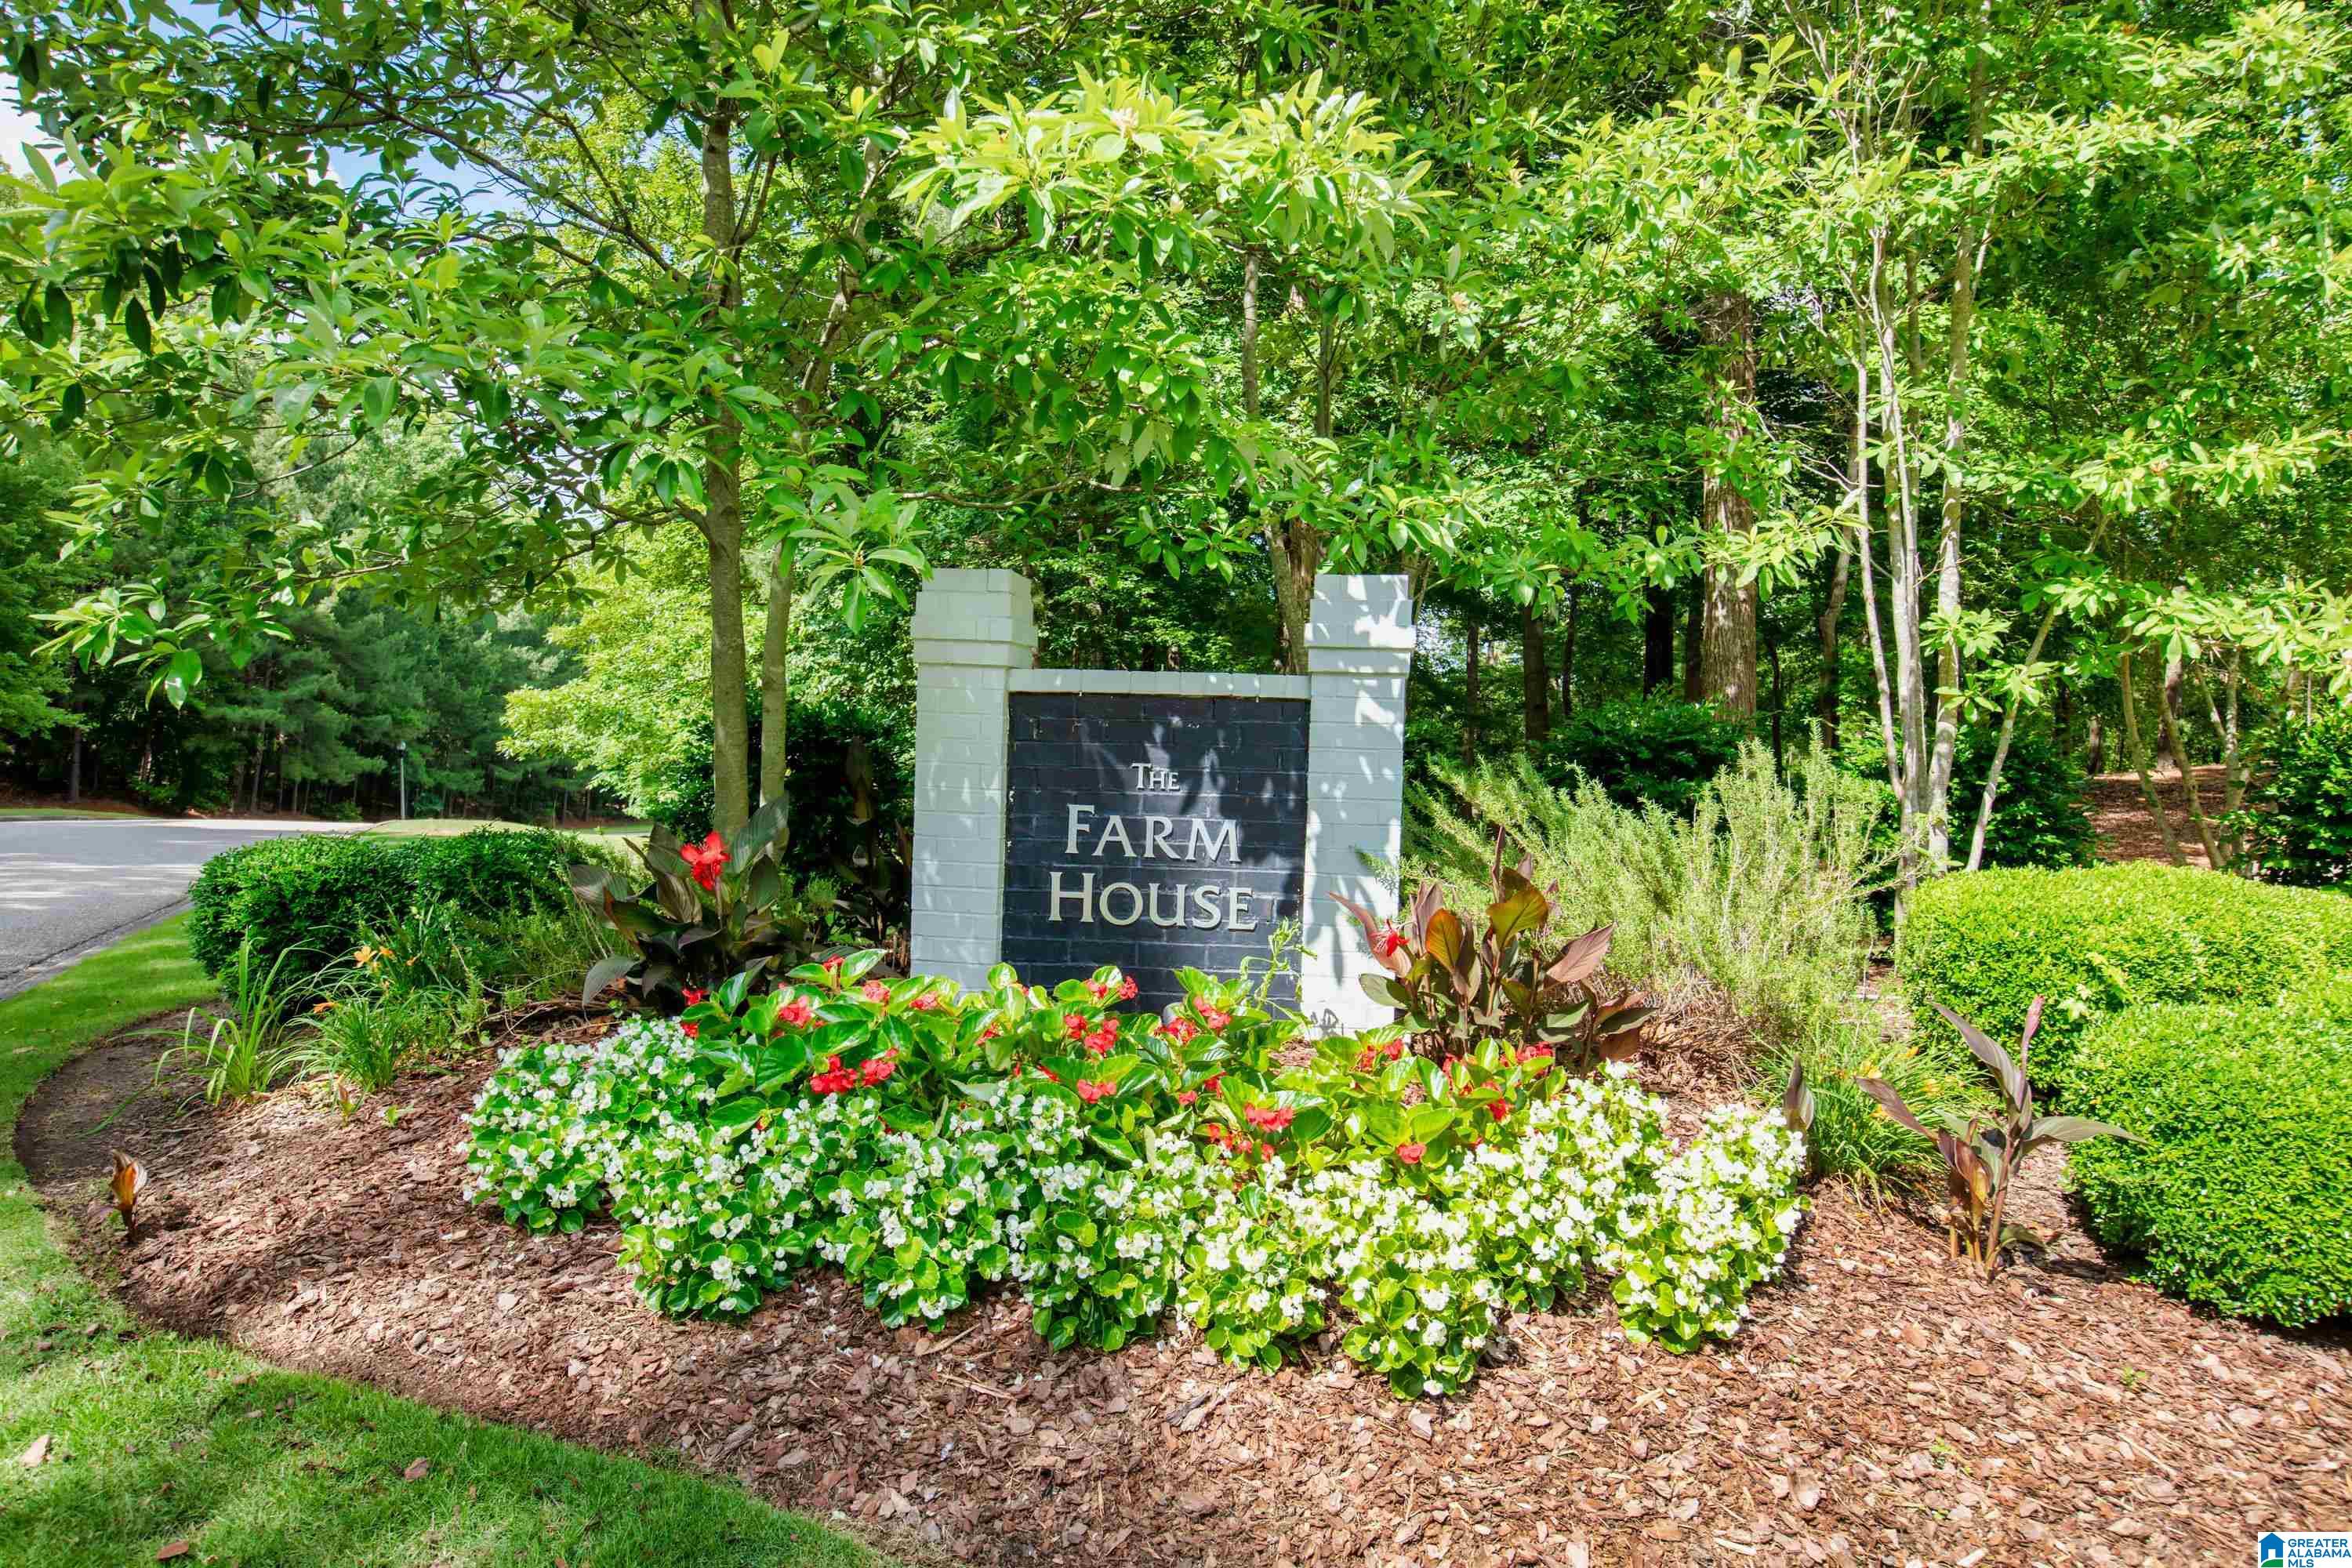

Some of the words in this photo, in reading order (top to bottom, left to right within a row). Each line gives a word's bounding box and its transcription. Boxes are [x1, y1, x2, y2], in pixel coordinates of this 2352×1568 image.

[1131, 762, 1181, 790] THE
[1064, 803, 1243, 863] FARM
[1047, 871, 1259, 931] HOUSE
